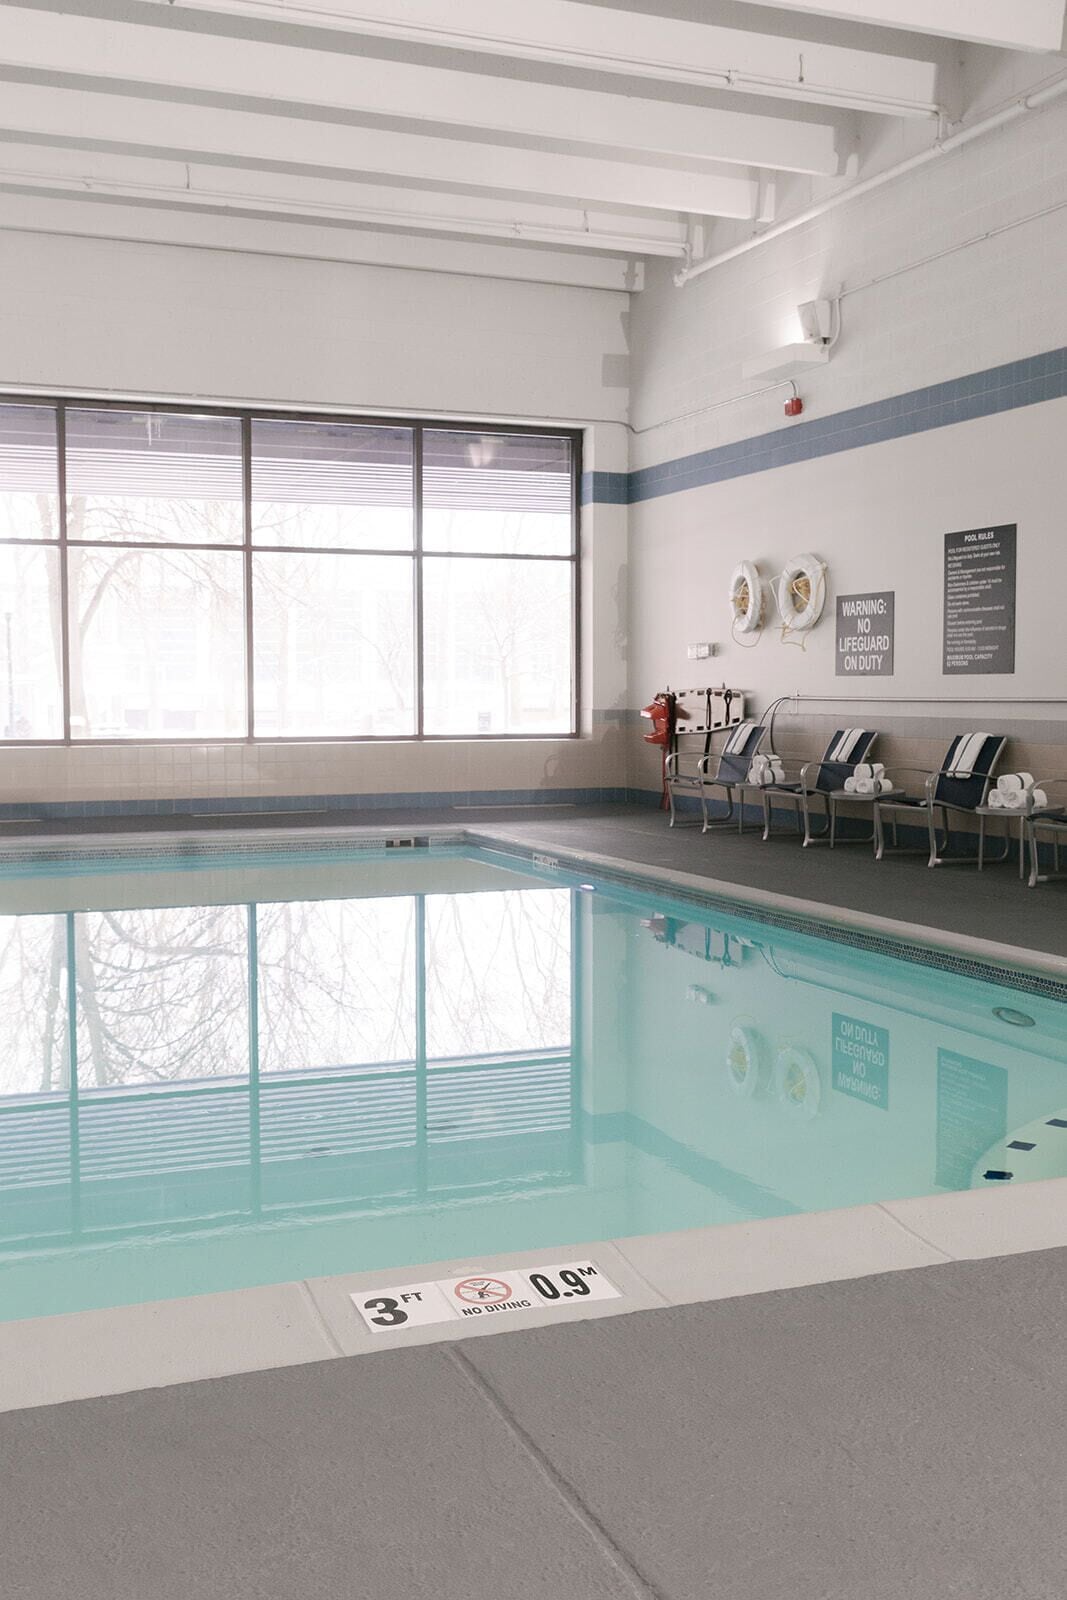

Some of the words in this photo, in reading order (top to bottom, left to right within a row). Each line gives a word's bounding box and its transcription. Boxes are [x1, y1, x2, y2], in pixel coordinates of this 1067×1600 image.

[964, 534, 978, 542] POOL
[978, 531, 994, 540] RULES
[842, 599, 886, 616] WARNING:
[857, 618, 870, 634] NO
[840, 636, 889, 652] LIFEGUARD
[844, 656, 857, 670] ON
[859, 655, 882, 670] DUTY
[529, 1270, 591, 1300] 0.9
[578, 1266, 598, 1277] M
[364, 1297, 408, 1326] 3
[400, 1292, 422, 1304] FT
[462, 1305, 482, 1316] NO
[484, 1300, 532, 1314] DIVING
